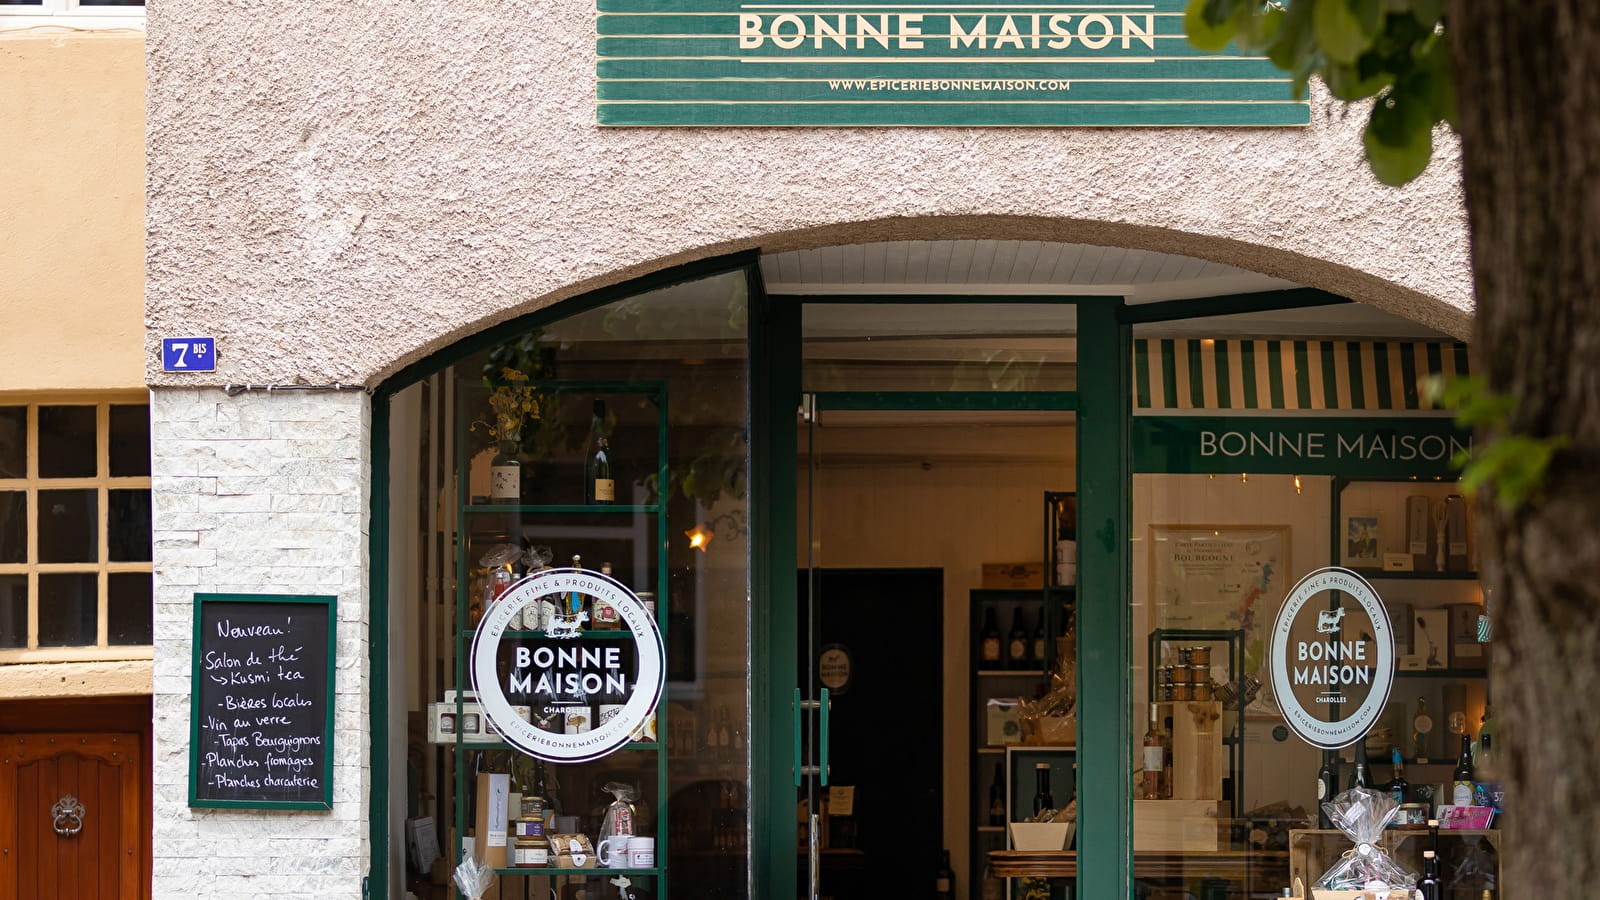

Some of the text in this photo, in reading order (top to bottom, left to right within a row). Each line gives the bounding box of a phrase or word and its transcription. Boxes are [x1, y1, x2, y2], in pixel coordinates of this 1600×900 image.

[739, 14, 1154, 50] BONNE MAISON
[829, 80, 1070, 91] WWW.EPICERIEBONNEMAISON.COM
[172, 343, 207, 367] 7 BIS
[1200, 431, 1473, 461] BONNE MAISON
[491, 578, 645, 639] EPICERIE FINE & PRODUITS LOCAUX
[1282, 595, 1302, 633] EPICERIE
[1304, 581, 1319, 595] FINE
[1329, 576, 1362, 596] PRODUITS
[1362, 596, 1382, 631] LOCAUX
[205, 645, 303, 670] Salon de thé
[516, 646, 621, 669] BONNE
[1298, 641, 1366, 661] BONNE
[230, 665, 304, 685] Kusmi tea
[509, 673, 626, 695] MAISON
[1294, 665, 1369, 685] MAISON
[272, 692, 312, 708] locales
[1315, 696, 1347, 704] CHAROLLES
[233, 718, 250, 728] au
[256, 716, 291, 725] verre
[1294, 705, 1372, 736] EPICERIEBONNEMAISON.COM
[251, 731, 321, 753] Bourguignons
[264, 752, 314, 772] fromages
